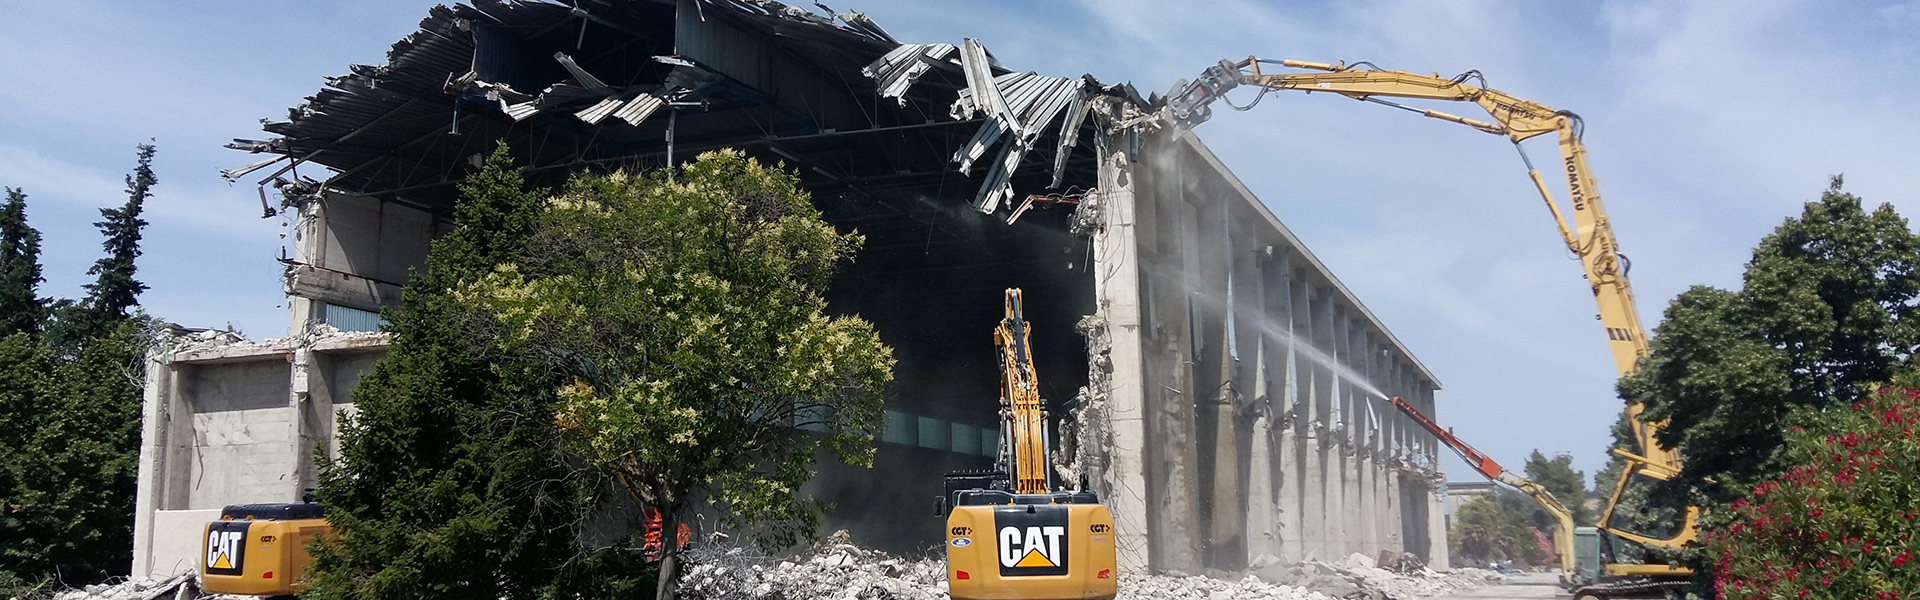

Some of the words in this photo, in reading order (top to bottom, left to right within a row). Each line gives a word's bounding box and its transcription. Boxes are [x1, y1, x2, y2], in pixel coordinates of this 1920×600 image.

[1565, 155, 1585, 212] KOMATSU
[951, 526, 968, 536] CGT
[999, 526, 1065, 568] CAT
[1090, 524, 1105, 533] CGT
[207, 530, 242, 570] CAT
